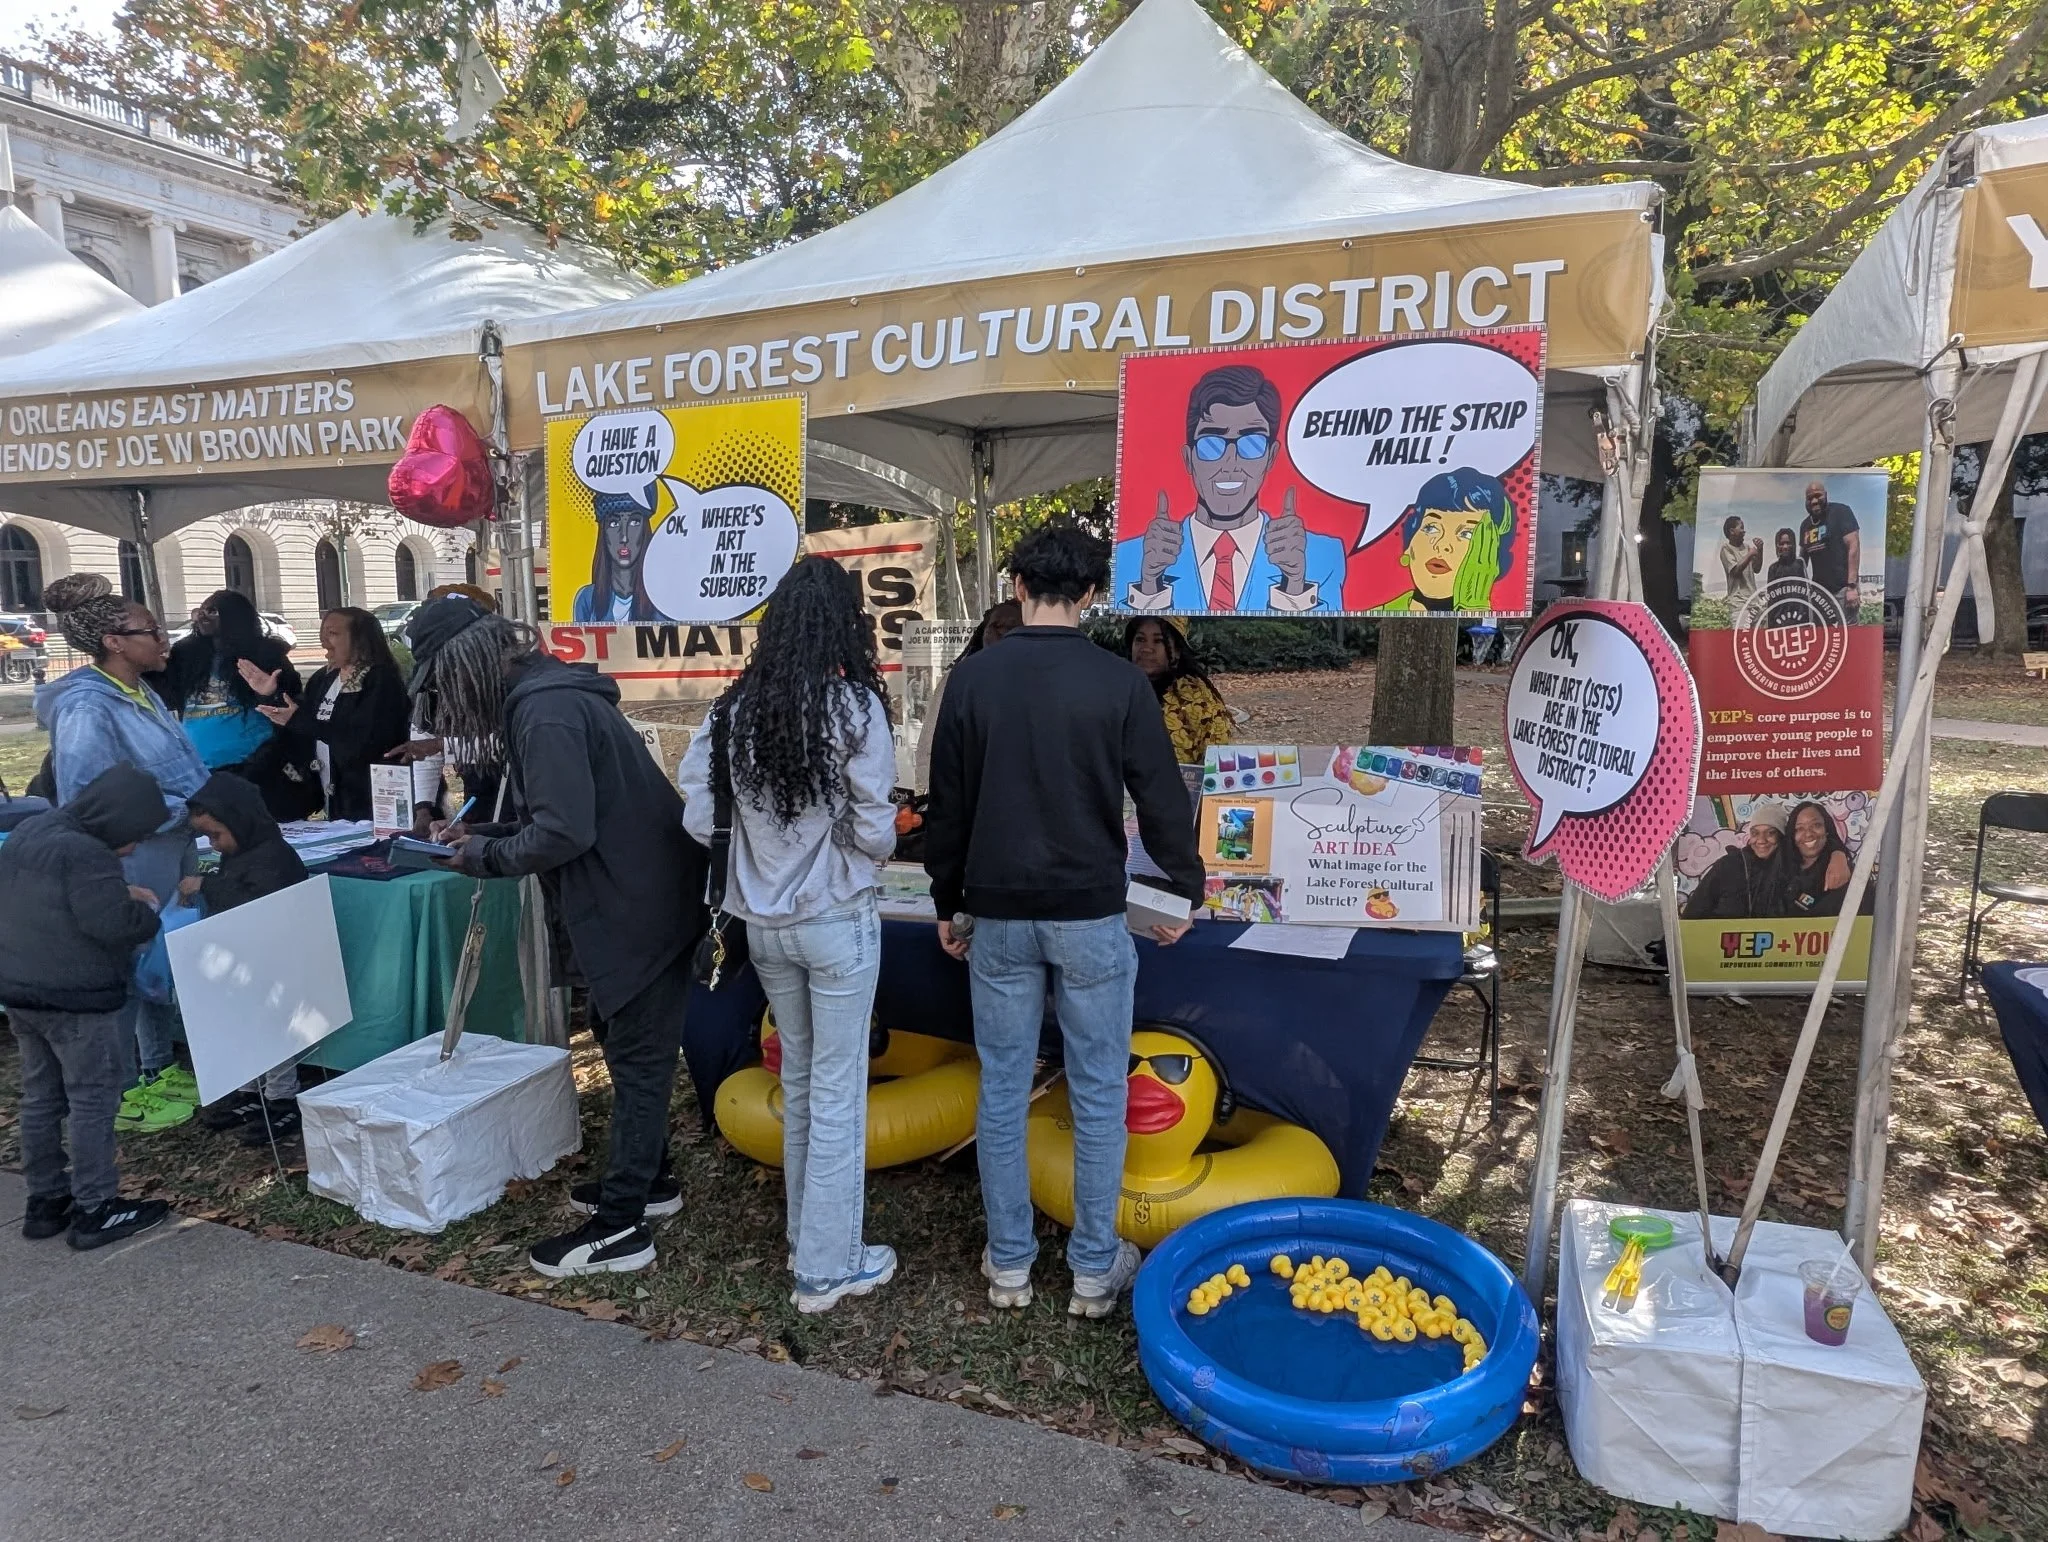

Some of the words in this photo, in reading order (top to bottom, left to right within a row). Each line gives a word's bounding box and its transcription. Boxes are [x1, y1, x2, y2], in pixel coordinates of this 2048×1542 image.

[537, 356, 655, 415] LAKE
[665, 329, 861, 399] FOREST
[872, 294, 1190, 374] CULTURAL
[1209, 259, 1566, 345] DISTRICT
[9, 398, 127, 436] ORLEANS
[132, 392, 206, 427] EAST
[211, 378, 355, 422] MATTERS
[1303, 406, 1393, 439] BEHIND
[1400, 404, 1447, 434] THE
[1450, 400, 1528, 432] STRIP
[77, 438, 108, 469] OF
[116, 434, 164, 467] JOE
[165, 431, 193, 464] W
[204, 425, 314, 463] BROWN
[320, 415, 407, 455] PARK
[587, 430, 594, 453] I
[601, 425, 639, 451] HAVE
[645, 424, 657, 448] A
[1366, 436, 1433, 467] MALL
[585, 450, 661, 478] QUESTION
[666, 514, 688, 537] OK,
[701, 504, 766, 530] WHERE'S
[715, 529, 746, 551] ART
[709, 554, 726, 575] IN
[730, 552, 757, 573] THE
[699, 575, 768, 598] SUBURB?
[1811, 591, 1836, 619] PROJECT
[908, 636, 921, 644] JOE
[933, 636, 962, 644] BROWN
[1551, 622, 1580, 668] OK,
[1765, 622, 1817, 660] YEP
[1742, 647, 1779, 691] EMPOWERING
[1780, 671, 1825, 693] COMMUNITY
[1823, 632, 1841, 672] TOGETHER
[1529, 670, 1559, 697] WHAT
[1559, 674, 1583, 704] ART
[1542, 701, 1564, 727] ARE
[1566, 705, 1580, 730] IN
[1581, 706, 1602, 737] THE
[1708, 710, 1753, 724] YEP's
[1757, 713, 1786, 723] core
[1789, 711, 1840, 724] purpose
[1844, 708, 1856, 720] is
[1860, 710, 1871, 719] to
[1513, 718, 1537, 745] LAKE
[1536, 725, 1577, 757] FOREST
[1577, 736, 1636, 777] CULTURAL
[1707, 733, 1768, 744] empower
[1772, 730, 1812, 743] young
[1815, 727, 1857, 740] people
[1861, 728, 1873, 738] to
[1706, 751, 1761, 763] improve
[1766, 748, 1799, 760] their
[1802, 747, 1831, 758] lives
[1834, 746, 1861, 757] and
[1537, 752, 1586, 788] DISTRICT
[1706, 769, 1727, 780] the
[1731, 768, 1762, 779] lives
[1766, 767, 1780, 778] of
[1783, 766, 1827, 778] others.
[1290, 787, 1405, 843] Sculpture
[1312, 841, 1349, 855] ART
[1352, 842, 1397, 856] IDEA
[1308, 858, 1342, 870] What
[1384, 861, 1404, 872] for
[1407, 861, 1427, 873] the
[1306, 877, 1336, 888] Lake
[1339, 877, 1377, 889] Forest
[1381, 879, 1433, 891] Cultural
[1306, 894, 1358, 907] District?
[1720, 931, 1774, 958] YEP
